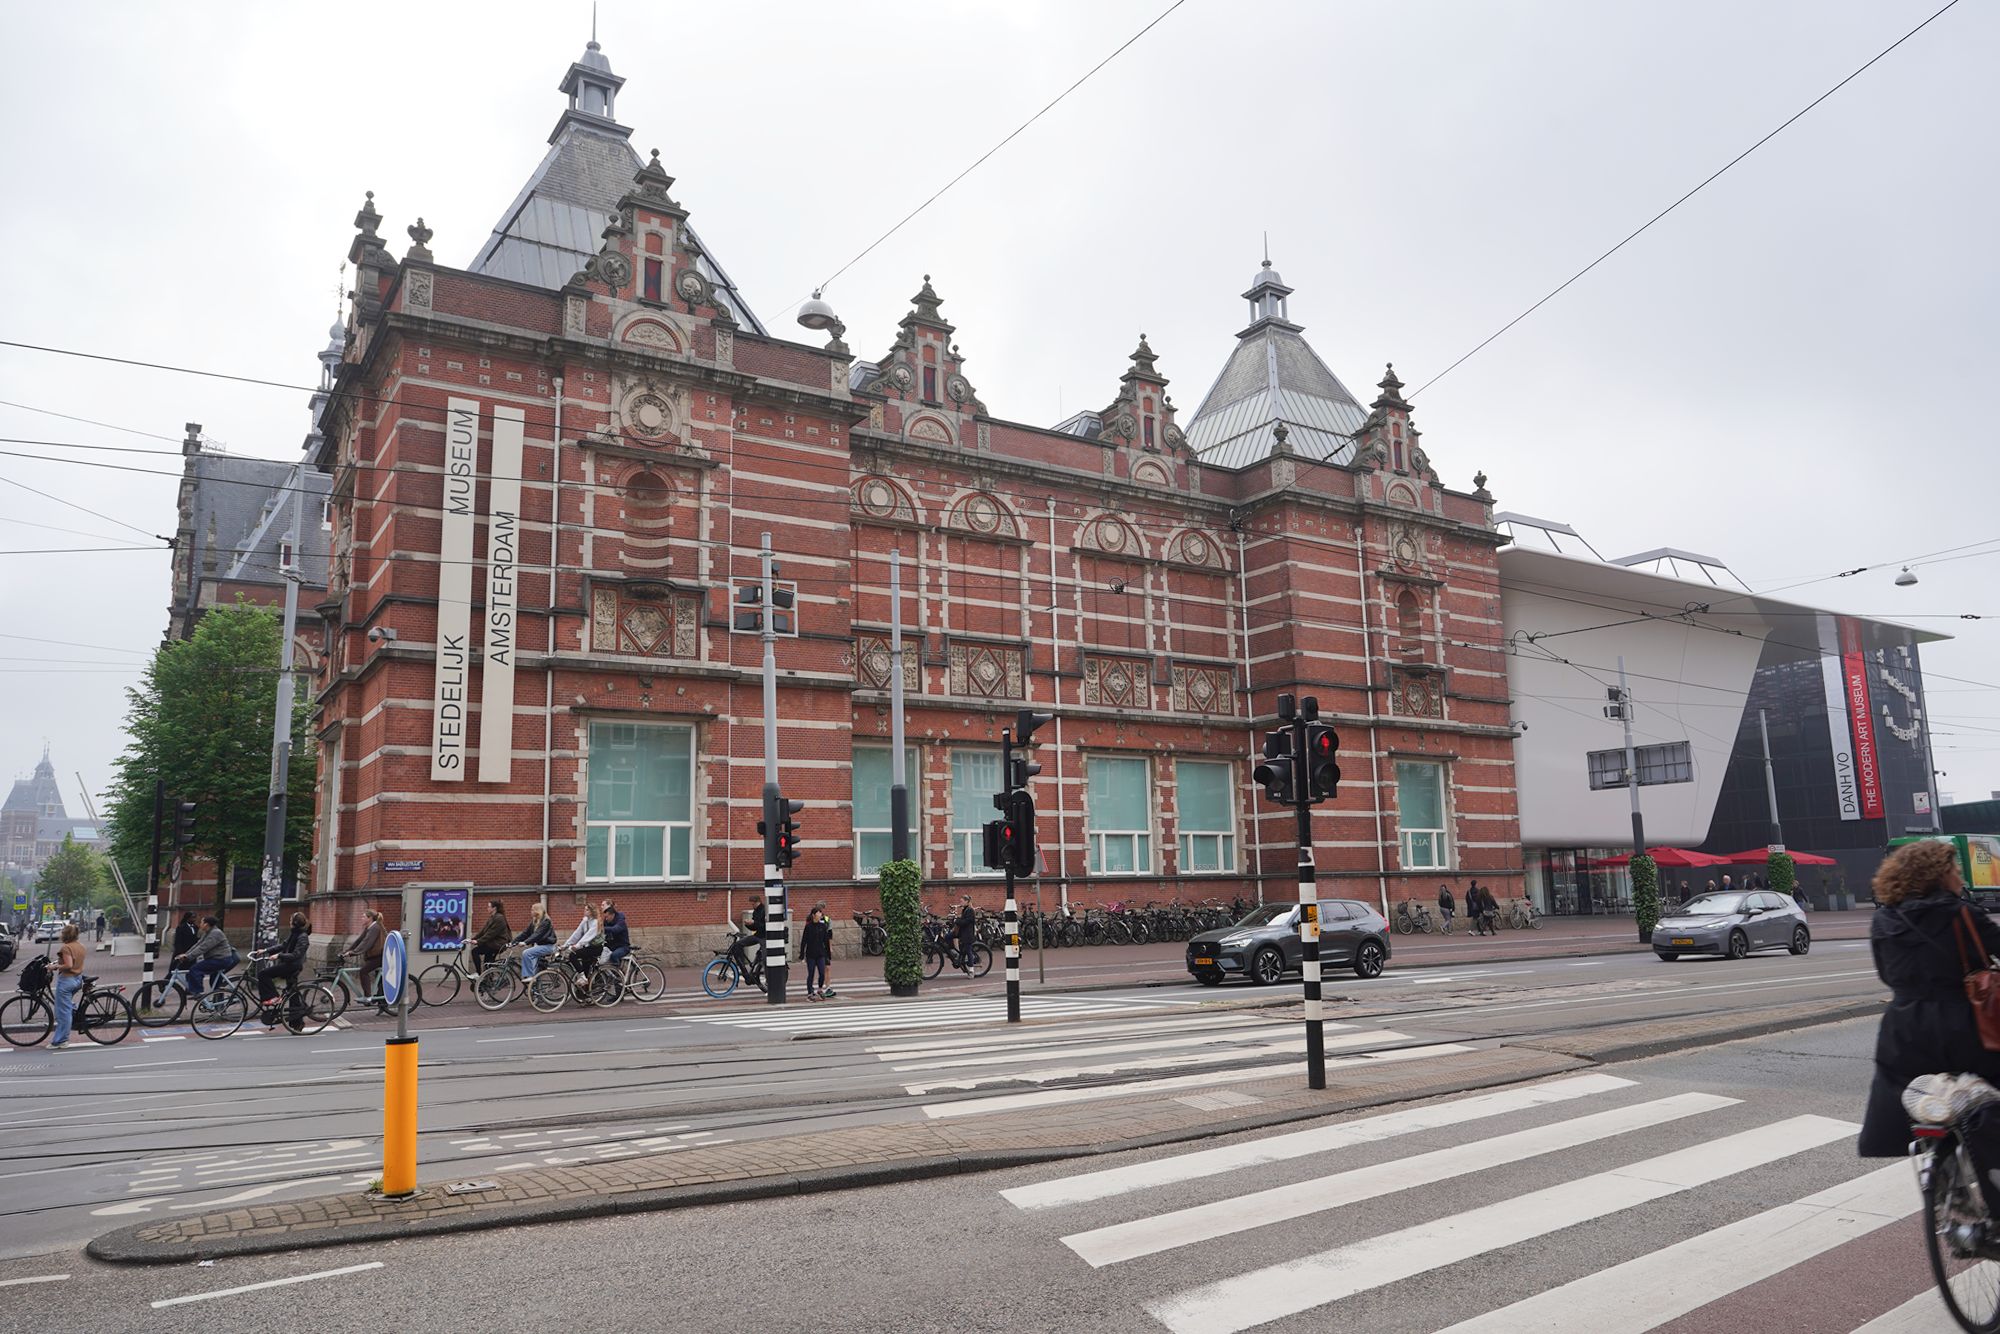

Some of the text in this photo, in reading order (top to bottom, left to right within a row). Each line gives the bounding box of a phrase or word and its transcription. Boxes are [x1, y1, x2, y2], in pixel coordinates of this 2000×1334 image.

[438, 409, 475, 769] STEDELIJK MUSEUM
[490, 511, 516, 666] AMSTERDAM
[1836, 752, 1856, 814] DANH VO
[1851, 674, 1878, 809] THE MODERN ART MUSEUM
[424, 898, 466, 914] 2001
